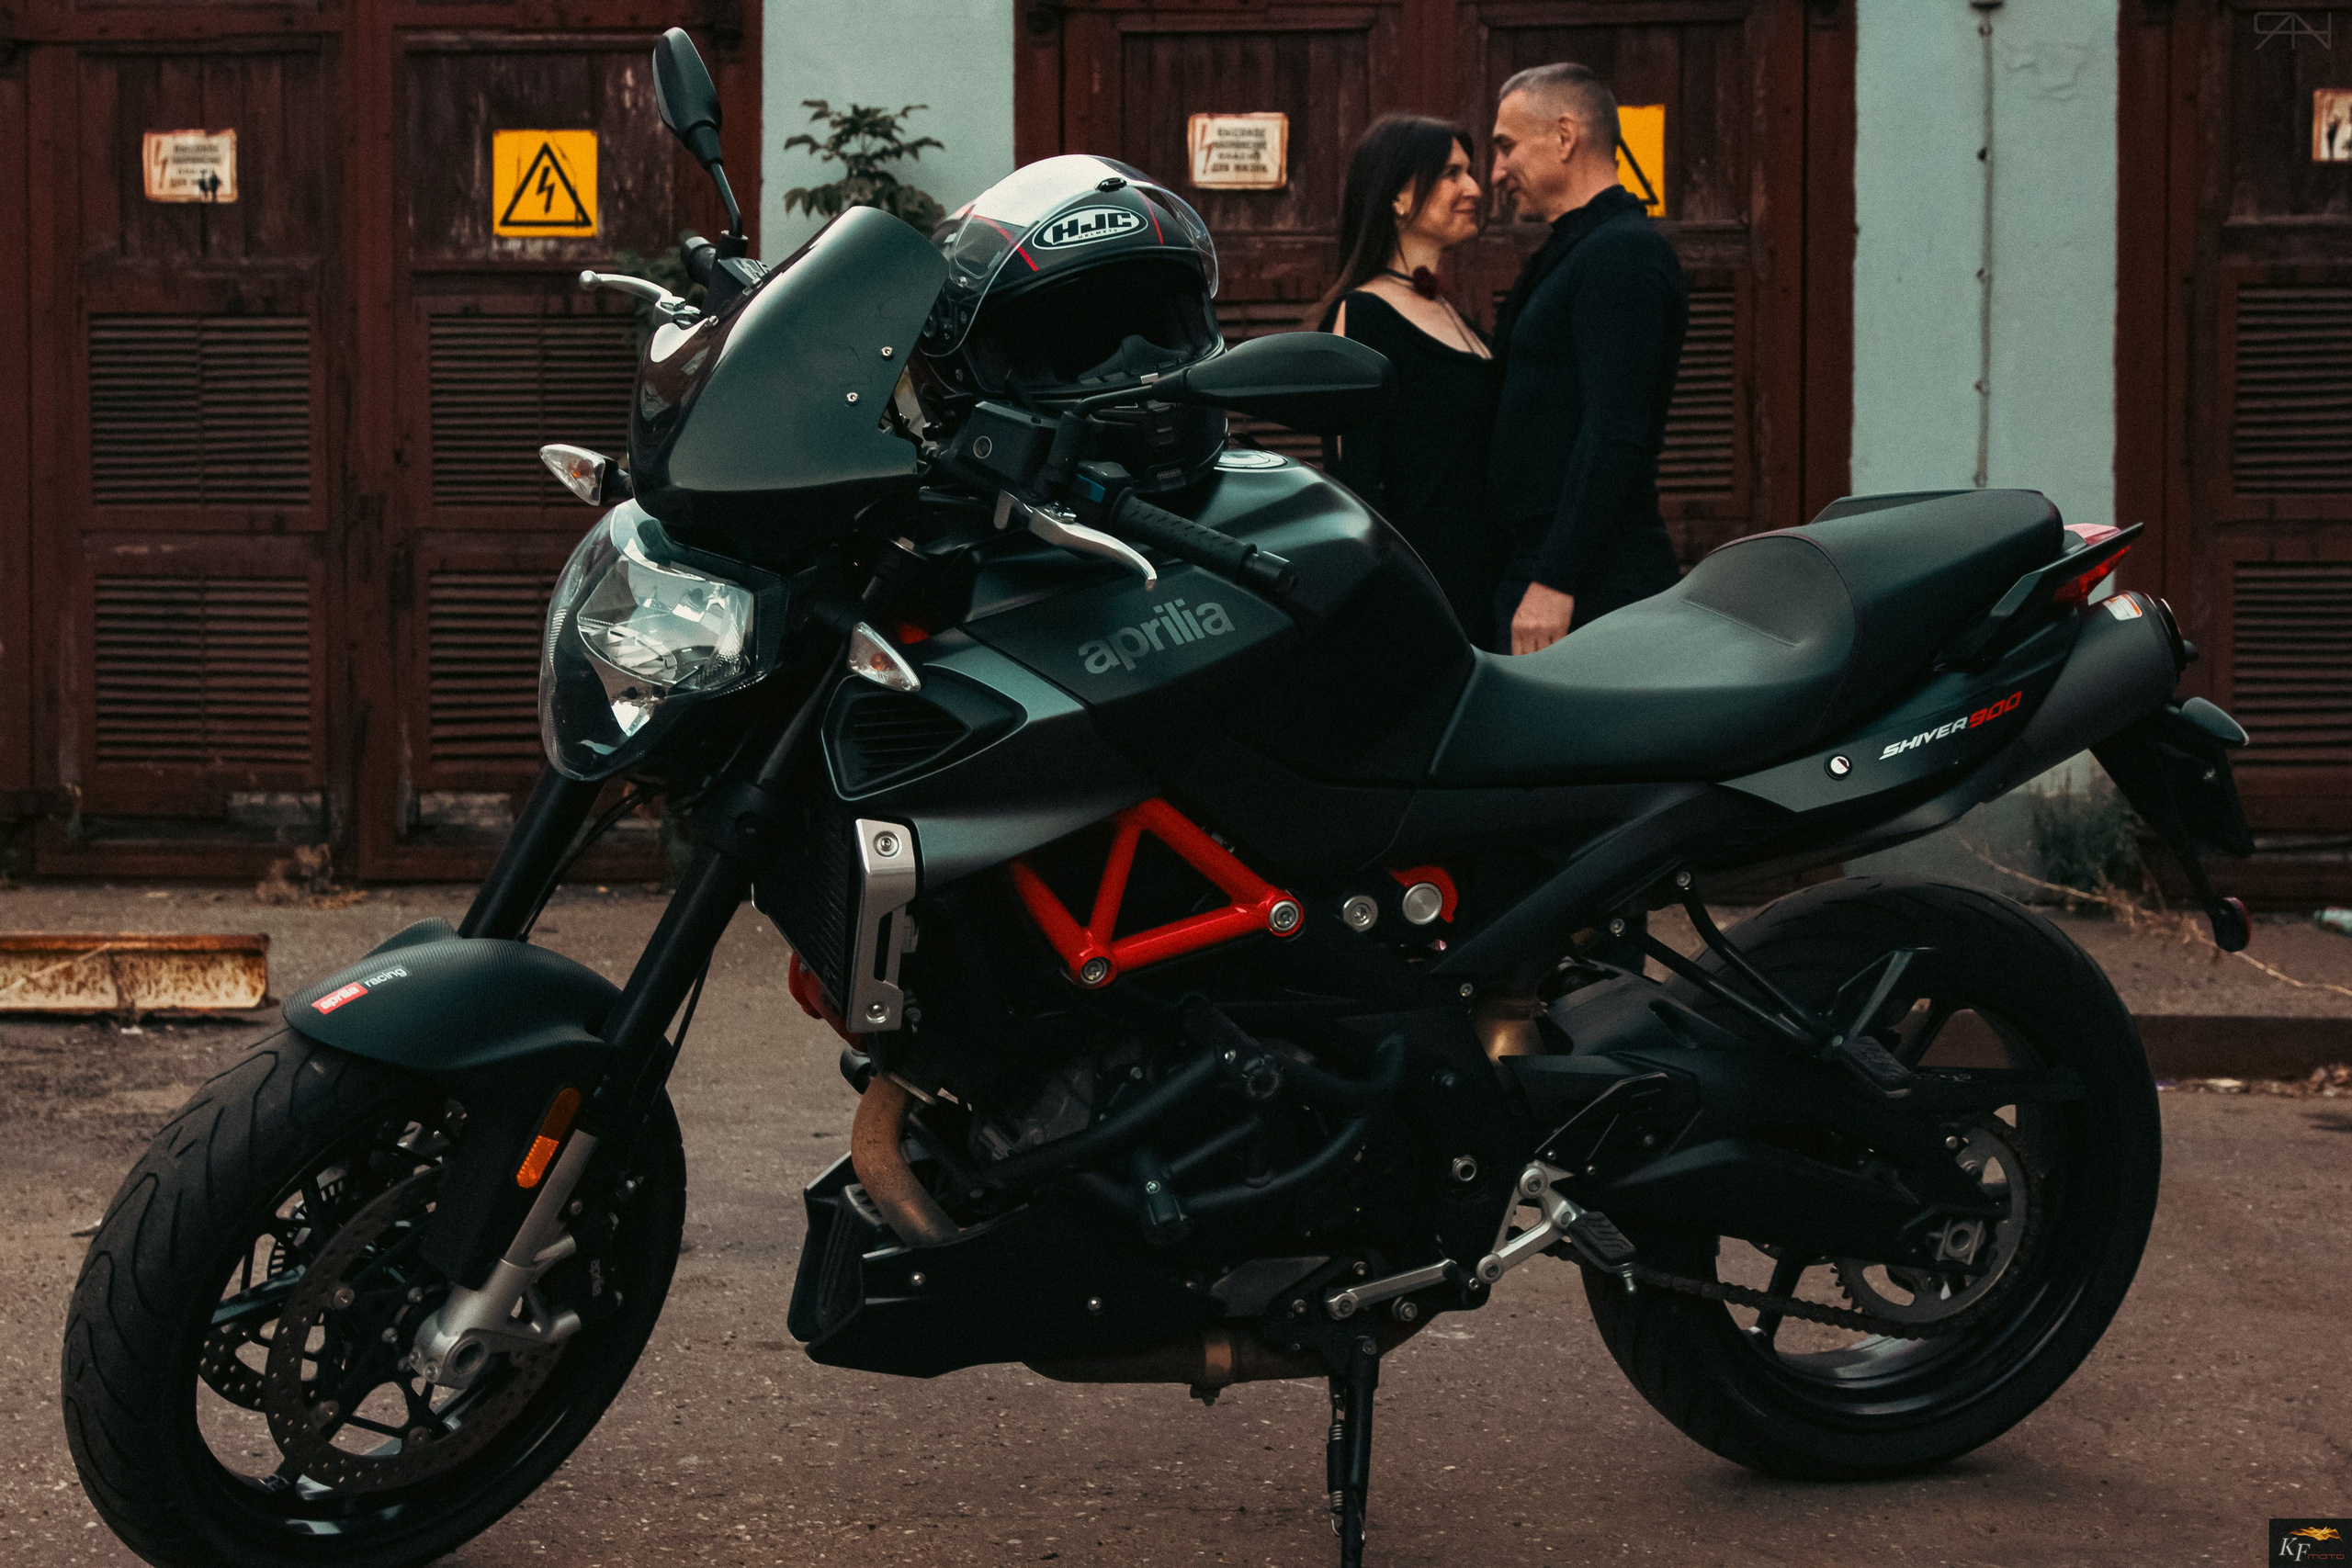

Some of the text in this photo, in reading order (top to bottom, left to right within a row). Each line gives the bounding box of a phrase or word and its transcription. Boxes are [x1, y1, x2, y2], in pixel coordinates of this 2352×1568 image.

[1052, 212, 1133, 244] HJC
[1078, 228, 1119, 240] HELMETS
[1078, 598, 1236, 674] aprilia
[364, 967, 408, 987] racing
